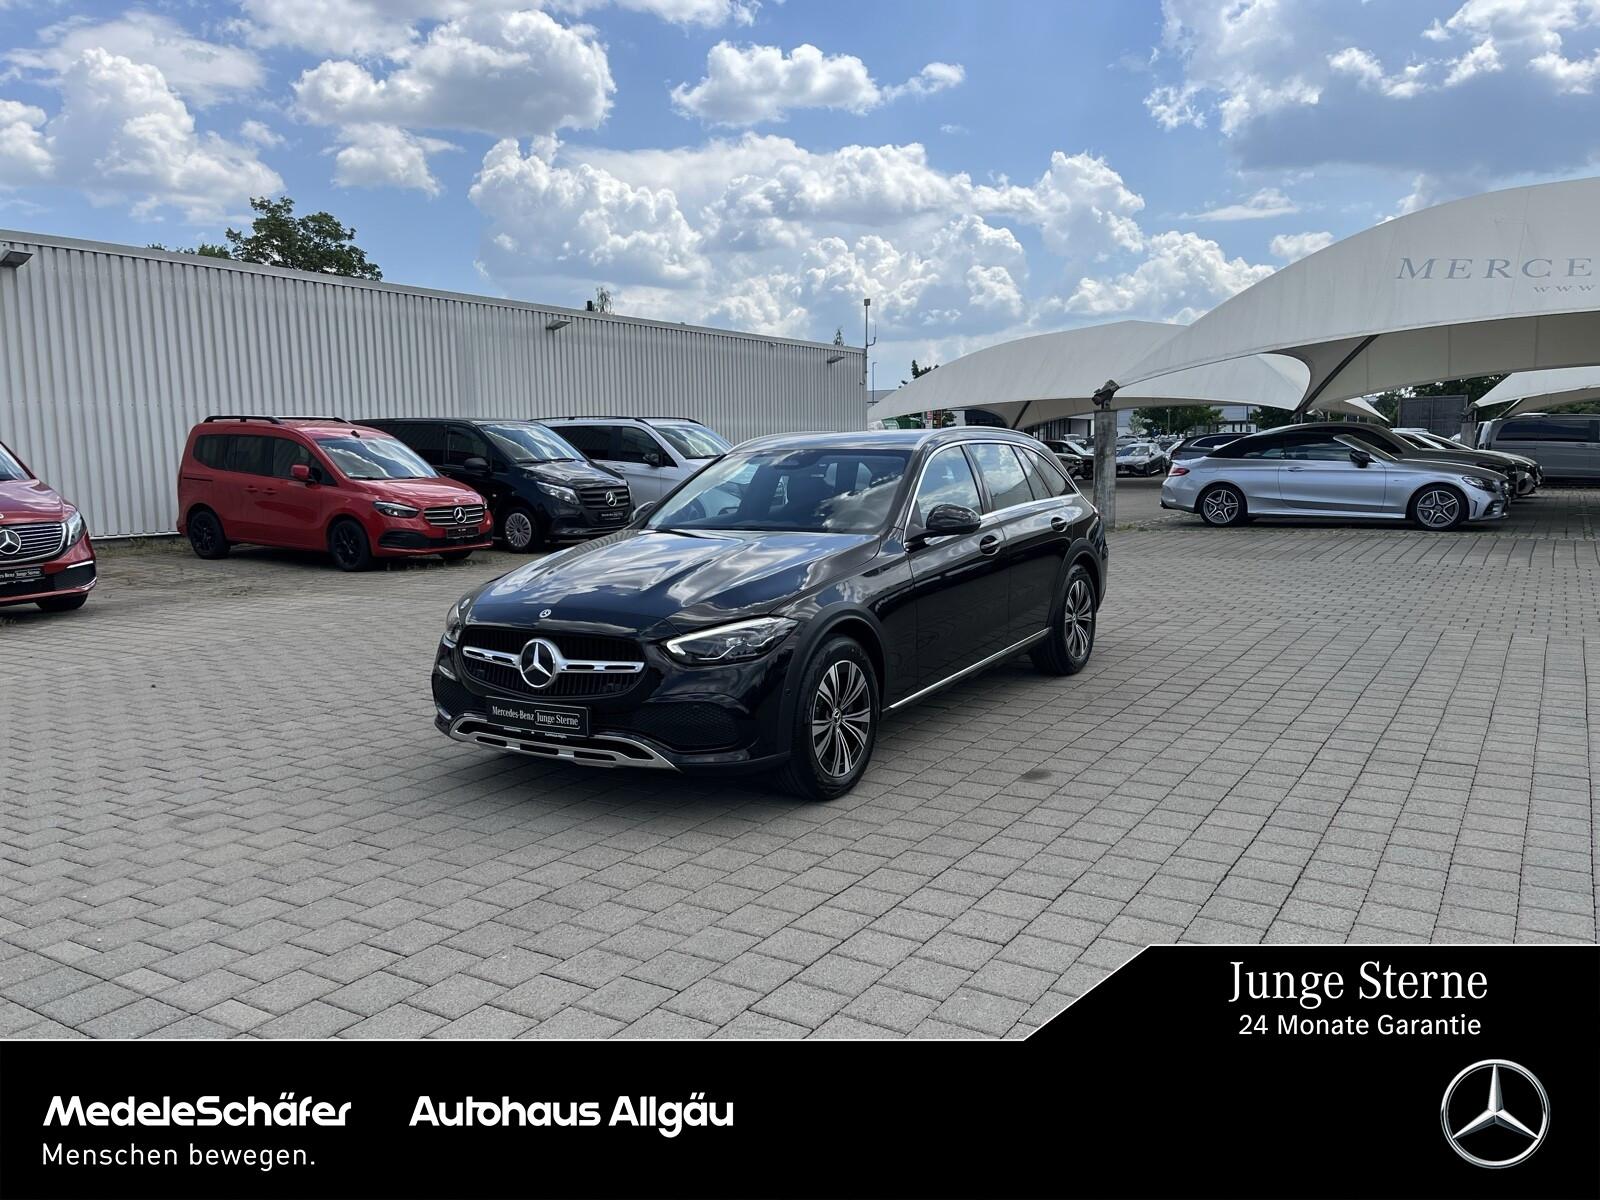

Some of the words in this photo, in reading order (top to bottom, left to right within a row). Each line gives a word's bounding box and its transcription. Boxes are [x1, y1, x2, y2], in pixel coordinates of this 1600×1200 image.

[1394, 256, 1593, 280] MERCE
[492, 705, 535, 721] Mercedes-Benz
[536, 712, 555, 725] Junge
[556, 714, 579, 726] Sterne
